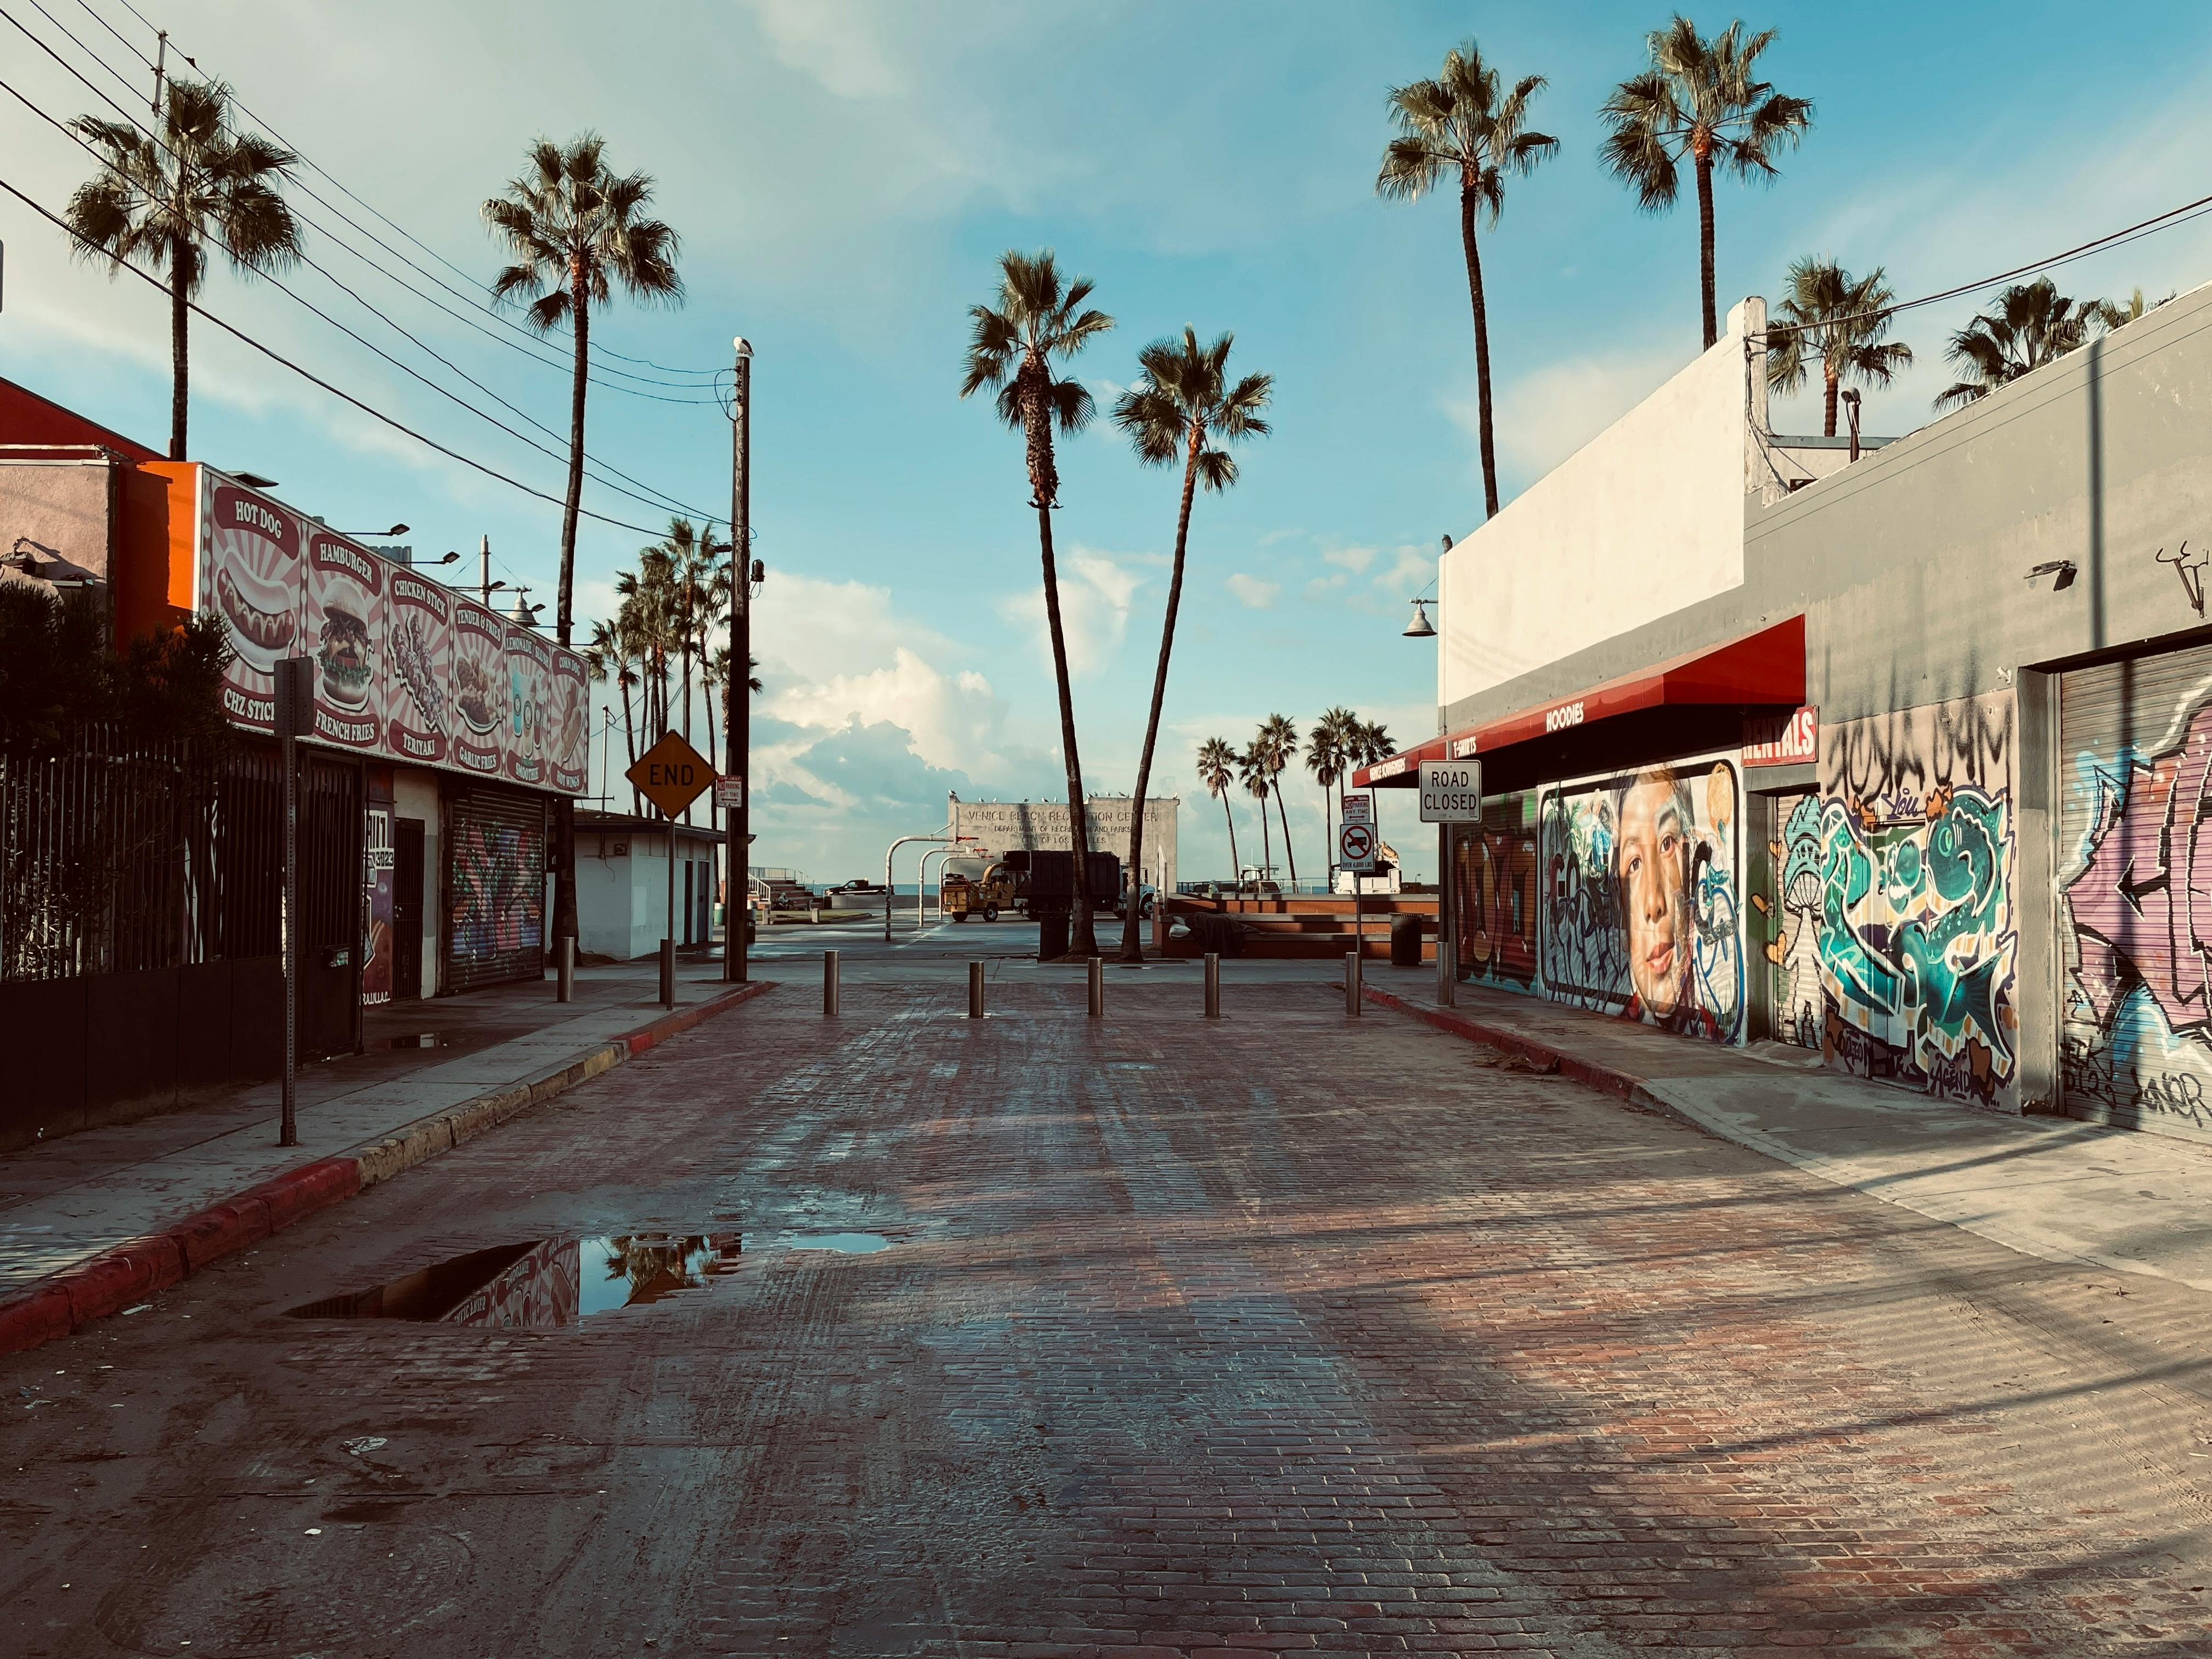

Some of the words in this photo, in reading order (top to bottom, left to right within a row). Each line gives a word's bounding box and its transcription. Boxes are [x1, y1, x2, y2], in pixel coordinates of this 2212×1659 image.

[235, 501, 258, 525] HOT
[259, 508, 282, 539] DOG
[320, 543, 373, 584] HAMBURGER
[394, 580, 426, 602] CHICKEN
[427, 589, 446, 618] STICK
[457, 610, 481, 624] TENDER
[481, 615, 485, 629] &
[486, 620, 501, 642] FRIES
[506, 637, 532, 654] LEMONADE
[559, 657, 571, 670] CORN
[571, 660, 580, 676] DOG
[224, 687, 246, 716] CHZ
[315, 708, 350, 741] FRENCH
[351, 723, 375, 741] FRIES
[1546, 701, 1584, 732] HOODIES
[403, 732, 435, 756] TERIYAKI
[1743, 711, 1814, 760] RENTALS
[459, 746, 481, 769] GARLIC
[481, 754, 496, 770] FRIES
[1453, 736, 1476, 759] T-SHIRTS
[515, 762, 539, 781] SMOOTHIE
[557, 770, 566, 787] HOT
[649, 764, 694, 786] END
[1431, 771, 1469, 787] ROAD
[718, 782, 725, 790] NO
[1424, 793, 1476, 810] CLOSED
[969, 811, 1006, 821] VENICE
[1011, 811, 1045, 821] BEACH
